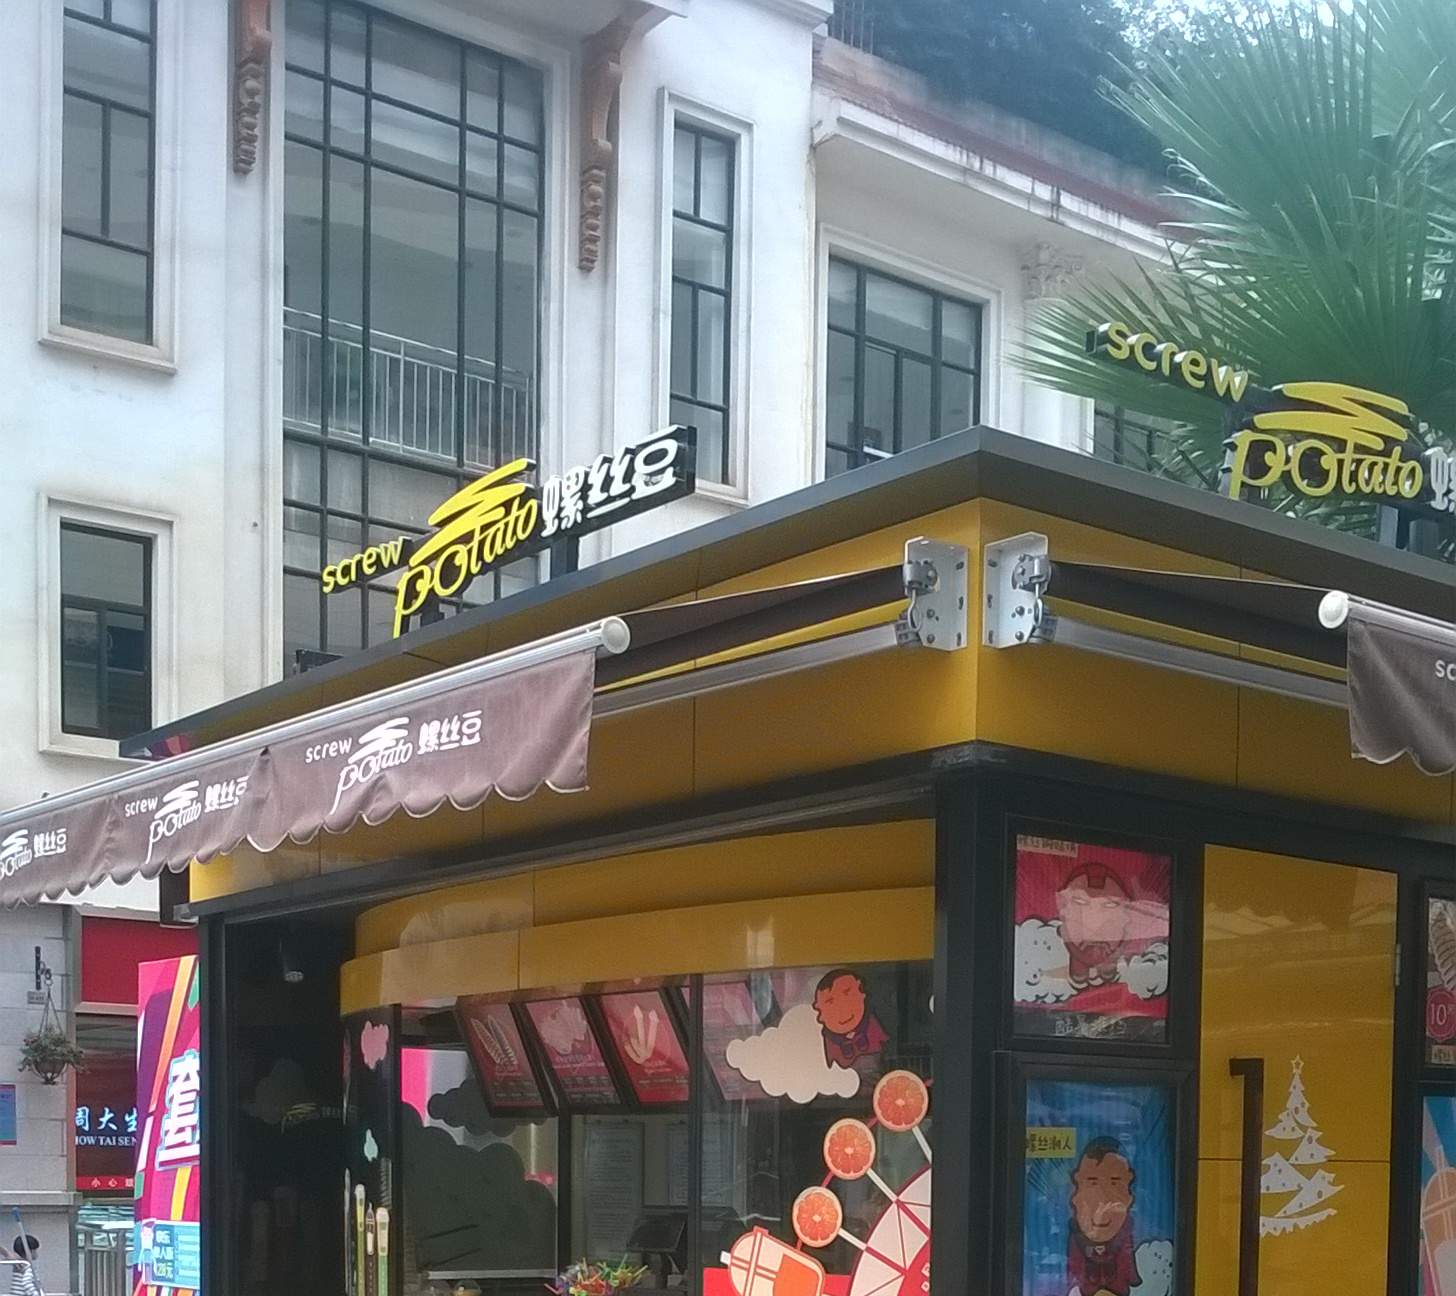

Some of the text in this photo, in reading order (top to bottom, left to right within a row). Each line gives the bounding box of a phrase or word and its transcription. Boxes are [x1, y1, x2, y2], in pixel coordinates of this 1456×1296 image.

[1102, 322, 1249, 402] screw
[1229, 430, 1424, 500] potato
[322, 425, 687, 639] screw potato 螺丝豆
[125, 796, 158, 817] screw
[146, 800, 201, 864] potato
[305, 710, 482, 815] screw potato 螺丝豆
